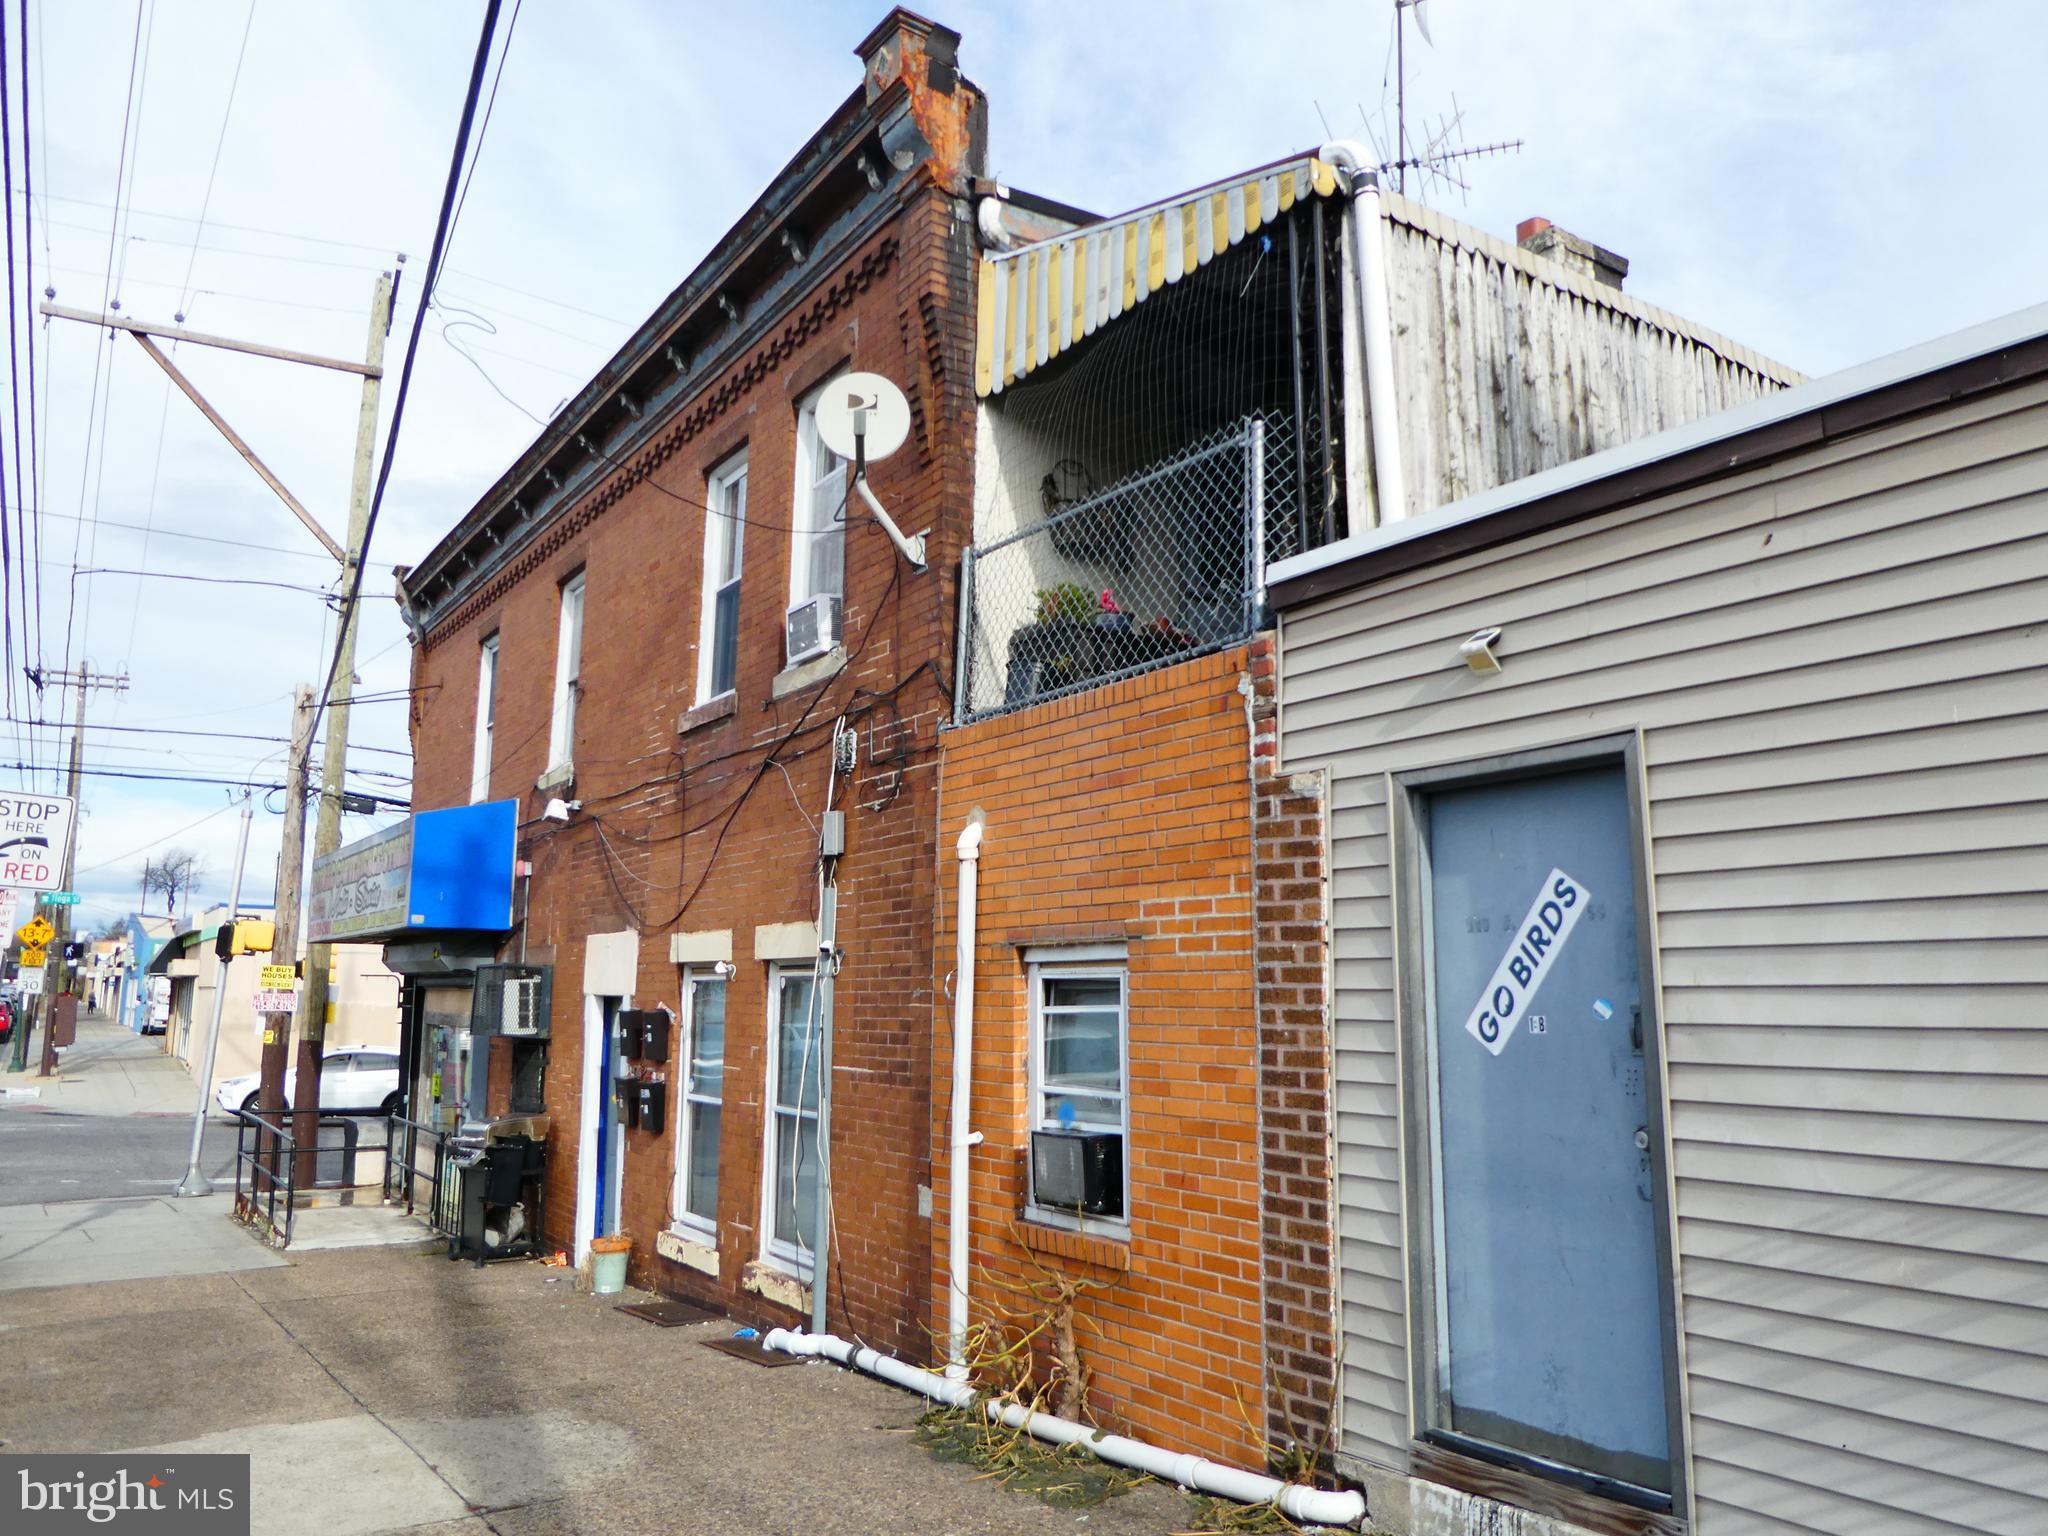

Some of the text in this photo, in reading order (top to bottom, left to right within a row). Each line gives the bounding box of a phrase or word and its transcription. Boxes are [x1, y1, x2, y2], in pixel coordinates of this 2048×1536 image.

[0, 799, 60, 820] STOP
[5, 820, 45, 834] HERE
[21, 848, 42, 860] ON
[4, 862, 49, 882] RED
[1477, 985, 1515, 1044] GO
[1508, 877, 1577, 989] BIRDS
[21, 980, 39, 990] 30
